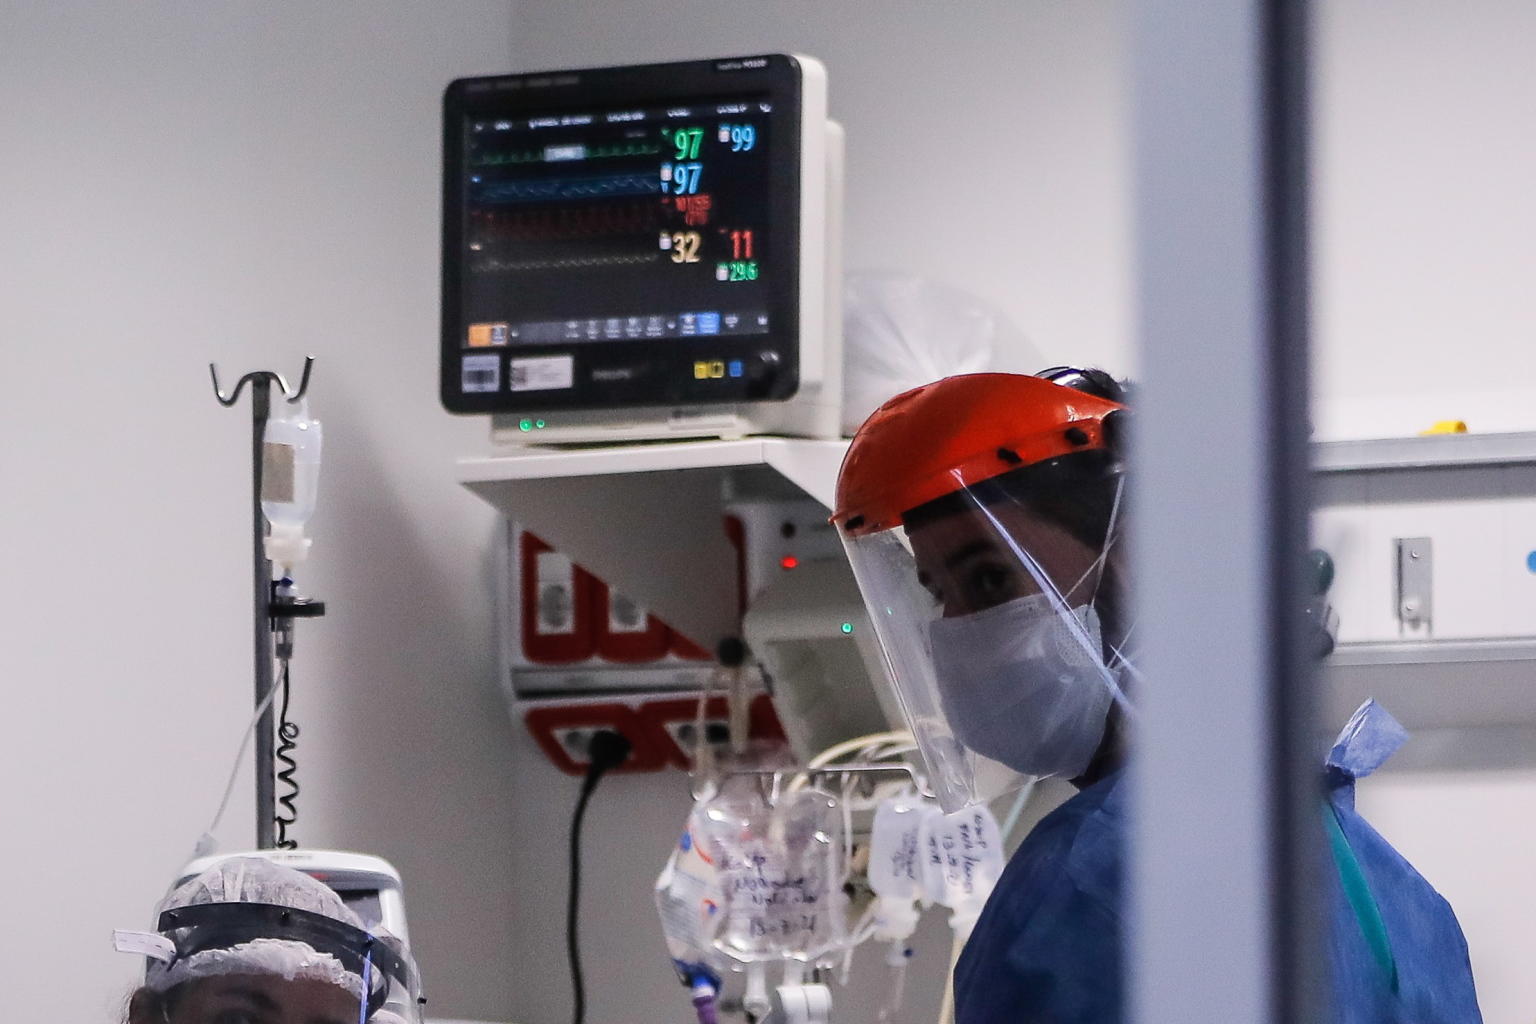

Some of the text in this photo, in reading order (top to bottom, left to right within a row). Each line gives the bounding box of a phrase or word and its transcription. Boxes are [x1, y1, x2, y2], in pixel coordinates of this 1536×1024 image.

[674, 128, 704, 160] 97
[731, 124, 756, 152] 99
[674, 163, 703, 195] 97
[671, 231, 700, 263] 32
[730, 230, 753, 259] 11
